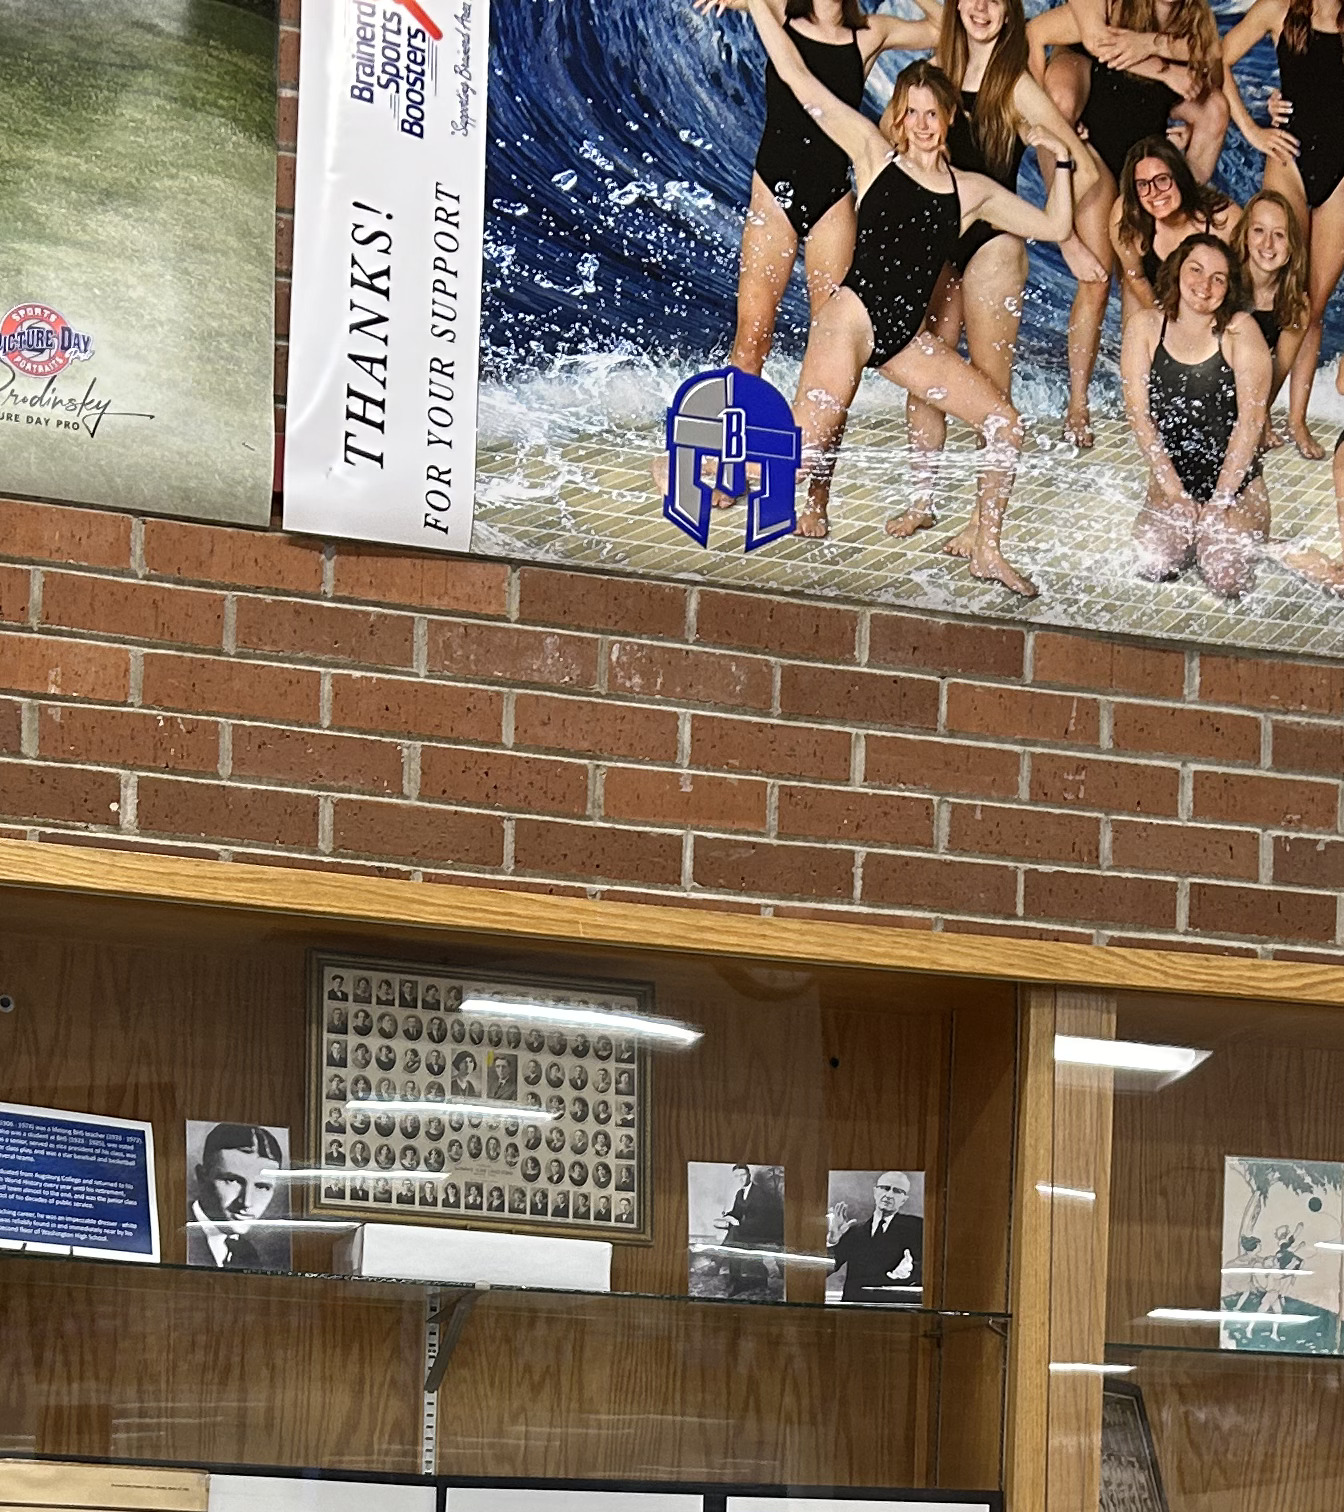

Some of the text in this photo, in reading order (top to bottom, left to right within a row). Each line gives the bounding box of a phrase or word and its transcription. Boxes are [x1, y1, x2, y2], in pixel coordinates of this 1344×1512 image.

[351, 0, 377, 104] Brainerd
[376, 9, 405, 94] Sports
[400, 26, 427, 139] Boosters
[11, 306, 58, 323] SPORTS
[60, 326, 92, 353] DAY
[343, 200, 394, 470] THANKS!
[13, 352, 65, 375] PORTRAITS
[423, 181, 460, 535] FOR YOUR SUPPORT
[25, 415, 51, 428] DAY
[55, 419, 81, 432] PRO
